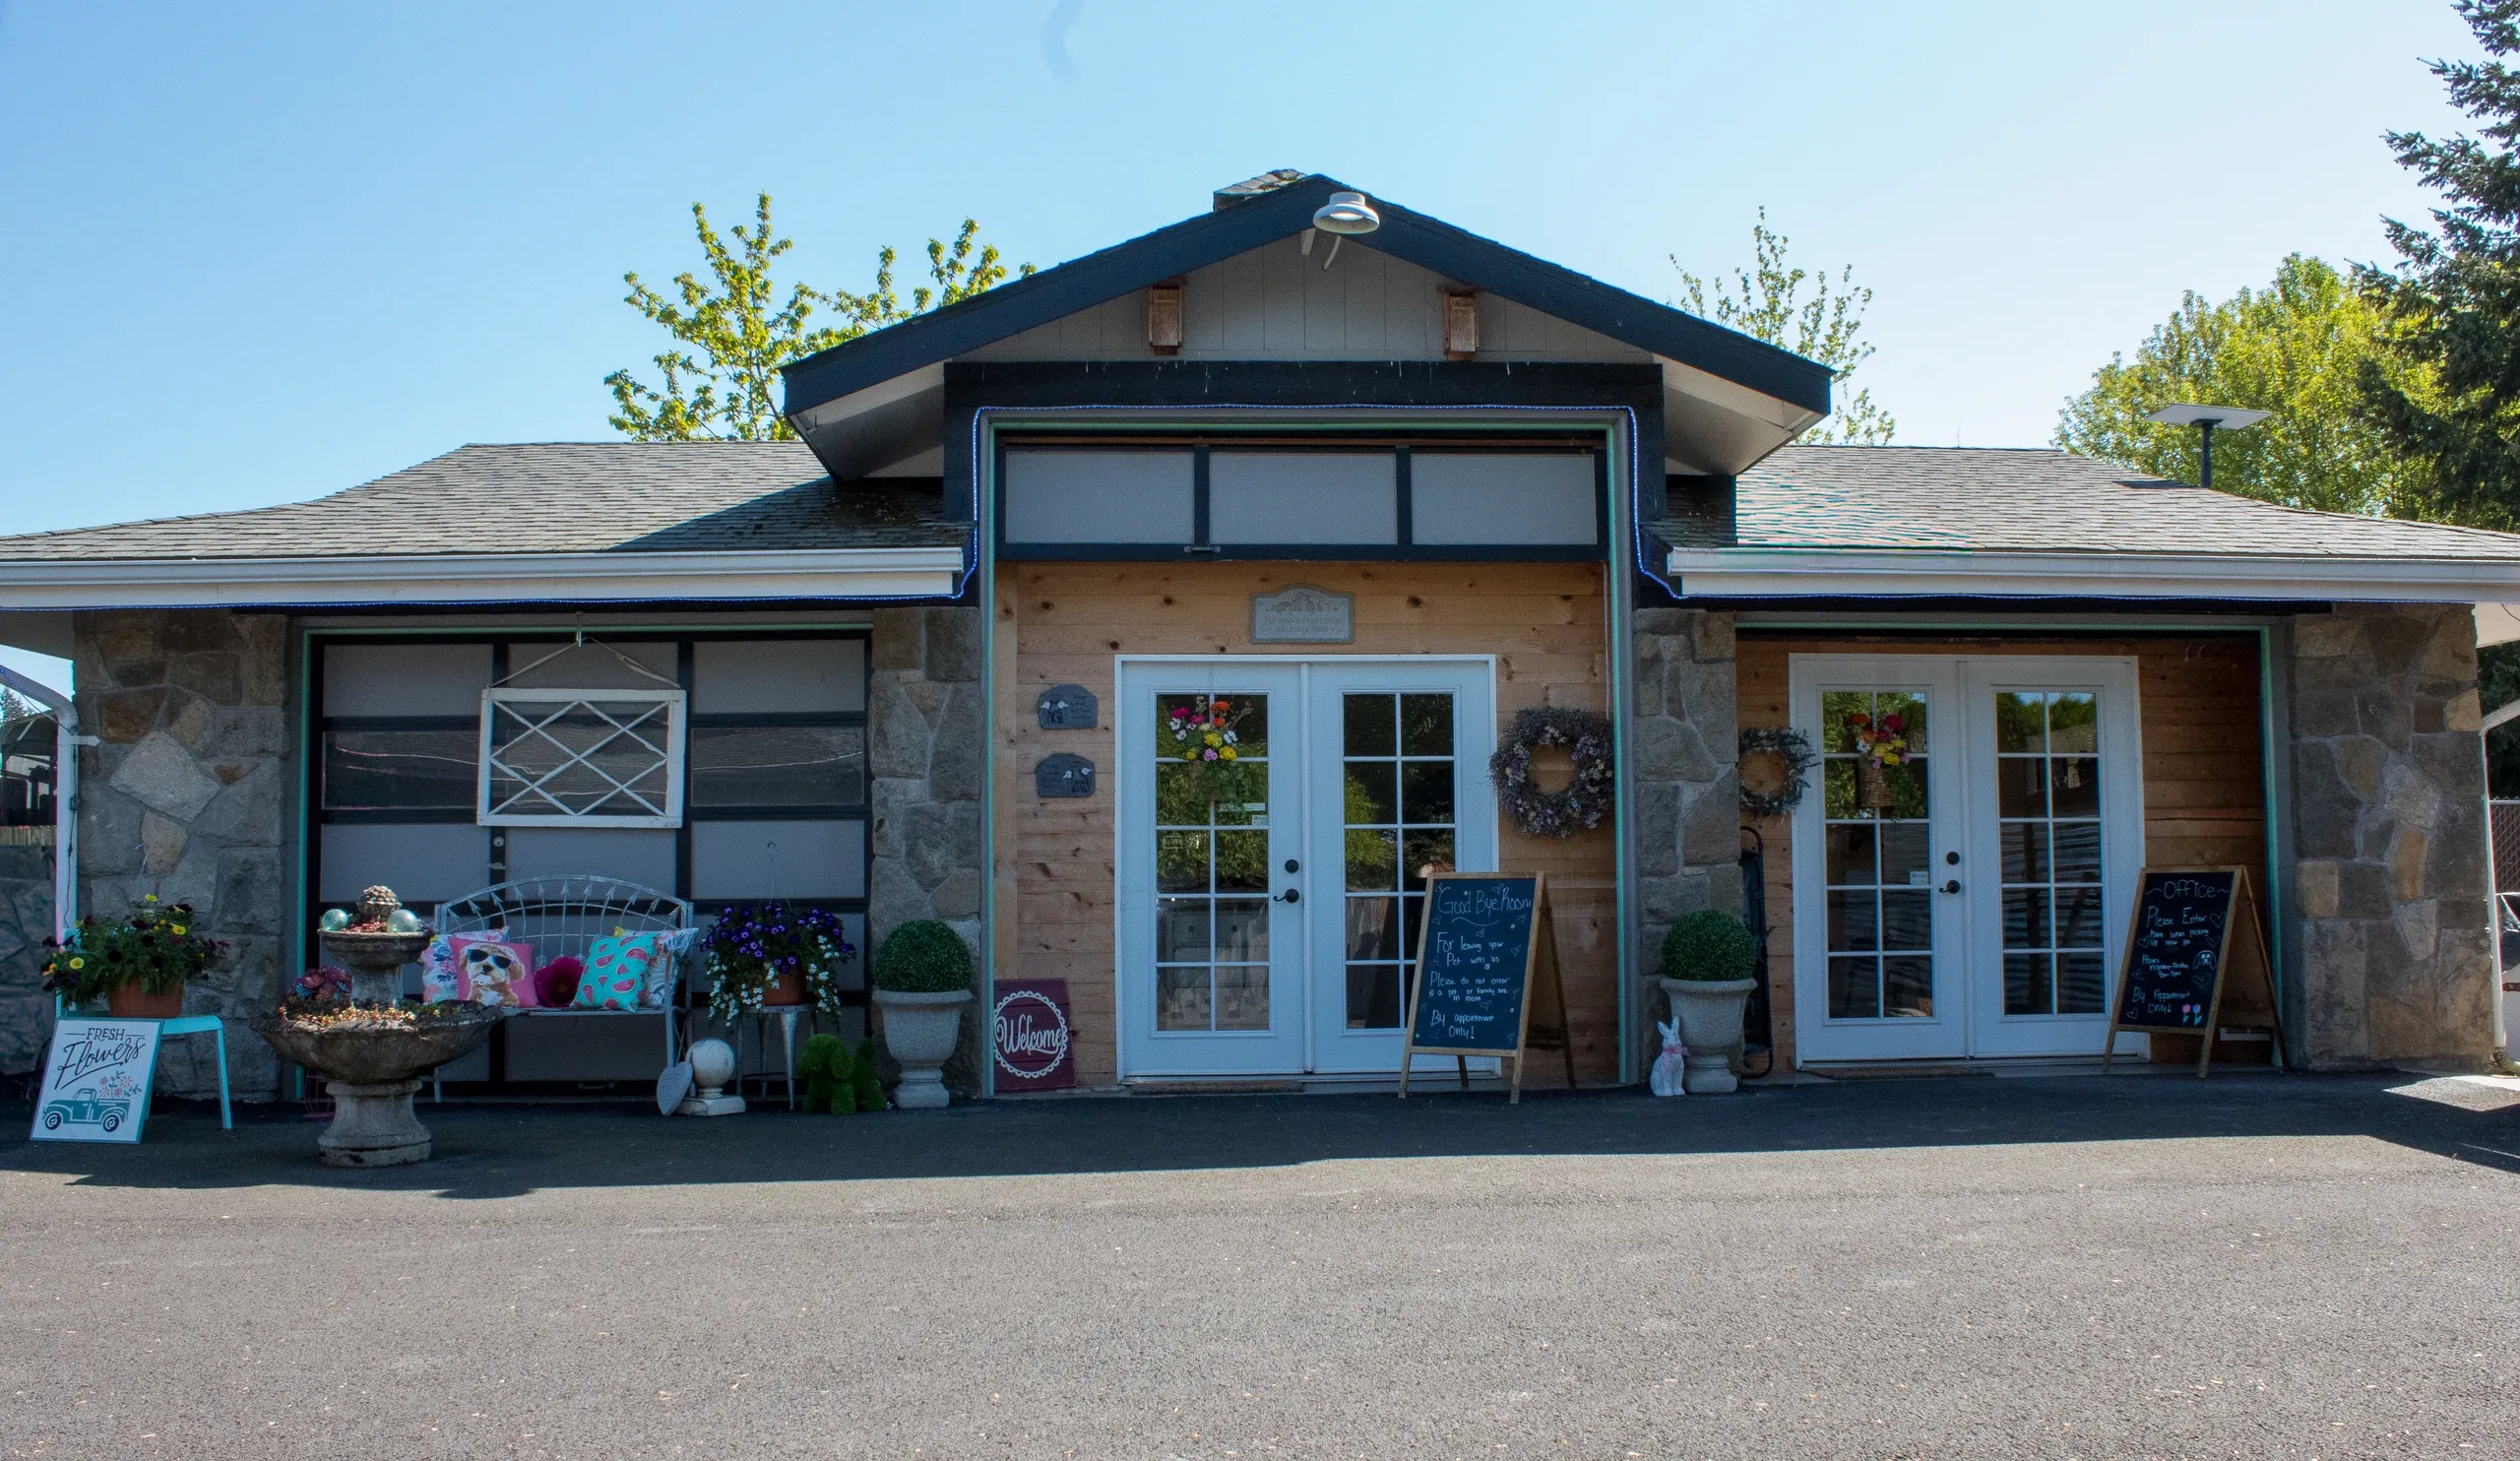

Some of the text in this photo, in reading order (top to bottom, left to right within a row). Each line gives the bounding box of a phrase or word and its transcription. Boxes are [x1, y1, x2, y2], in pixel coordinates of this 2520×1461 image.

[2163, 879, 2217, 899] Office
[1437, 886, 1532, 917] Good Bye Room
[2146, 906, 2207, 927] Please Enter
[1436, 931, 1505, 954] For leaving your
[1446, 953, 1462, 967] Pet
[1430, 971, 1456, 986] Please
[1448, 988, 1457, 997] pet
[2132, 986, 2145, 1003] By
[1430, 1009, 1446, 1027] By
[86, 1028, 126, 1042] FRESH
[994, 1014, 1062, 1055] Welcome
[1448, 1025, 1475, 1040] Only!
[54, 1037, 146, 1090] Flowers
